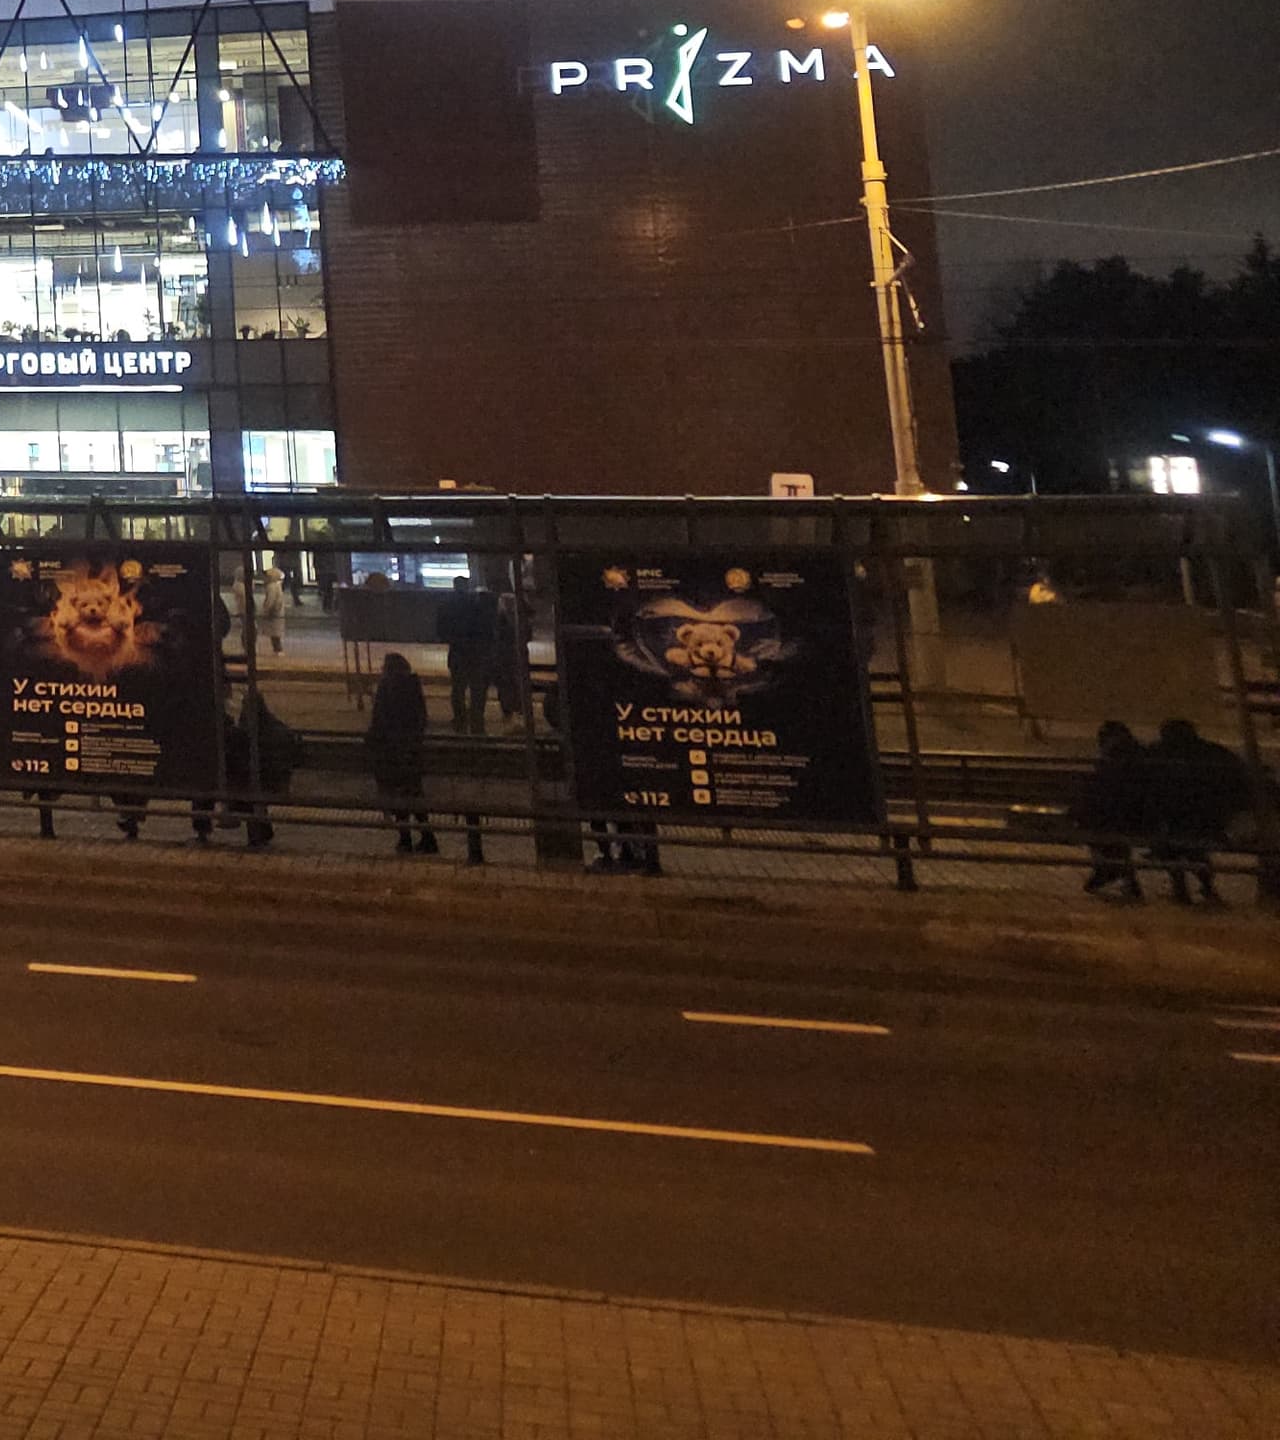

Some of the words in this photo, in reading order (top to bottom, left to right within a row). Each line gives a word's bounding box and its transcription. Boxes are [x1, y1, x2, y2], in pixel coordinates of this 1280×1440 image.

[104, 352, 192, 377] ЦЕНТР
[13, 678, 28, 694] У
[34, 682, 117, 698] стихии
[13, 699, 53, 712] нет
[59, 699, 145, 718] сердца
[616, 703, 633, 720] У
[642, 708, 741, 724] стихии
[618, 726, 664, 742] нет
[673, 727, 777, 747] сердца
[25, 760, 49, 773] 112
[641, 791, 670, 806] 112
